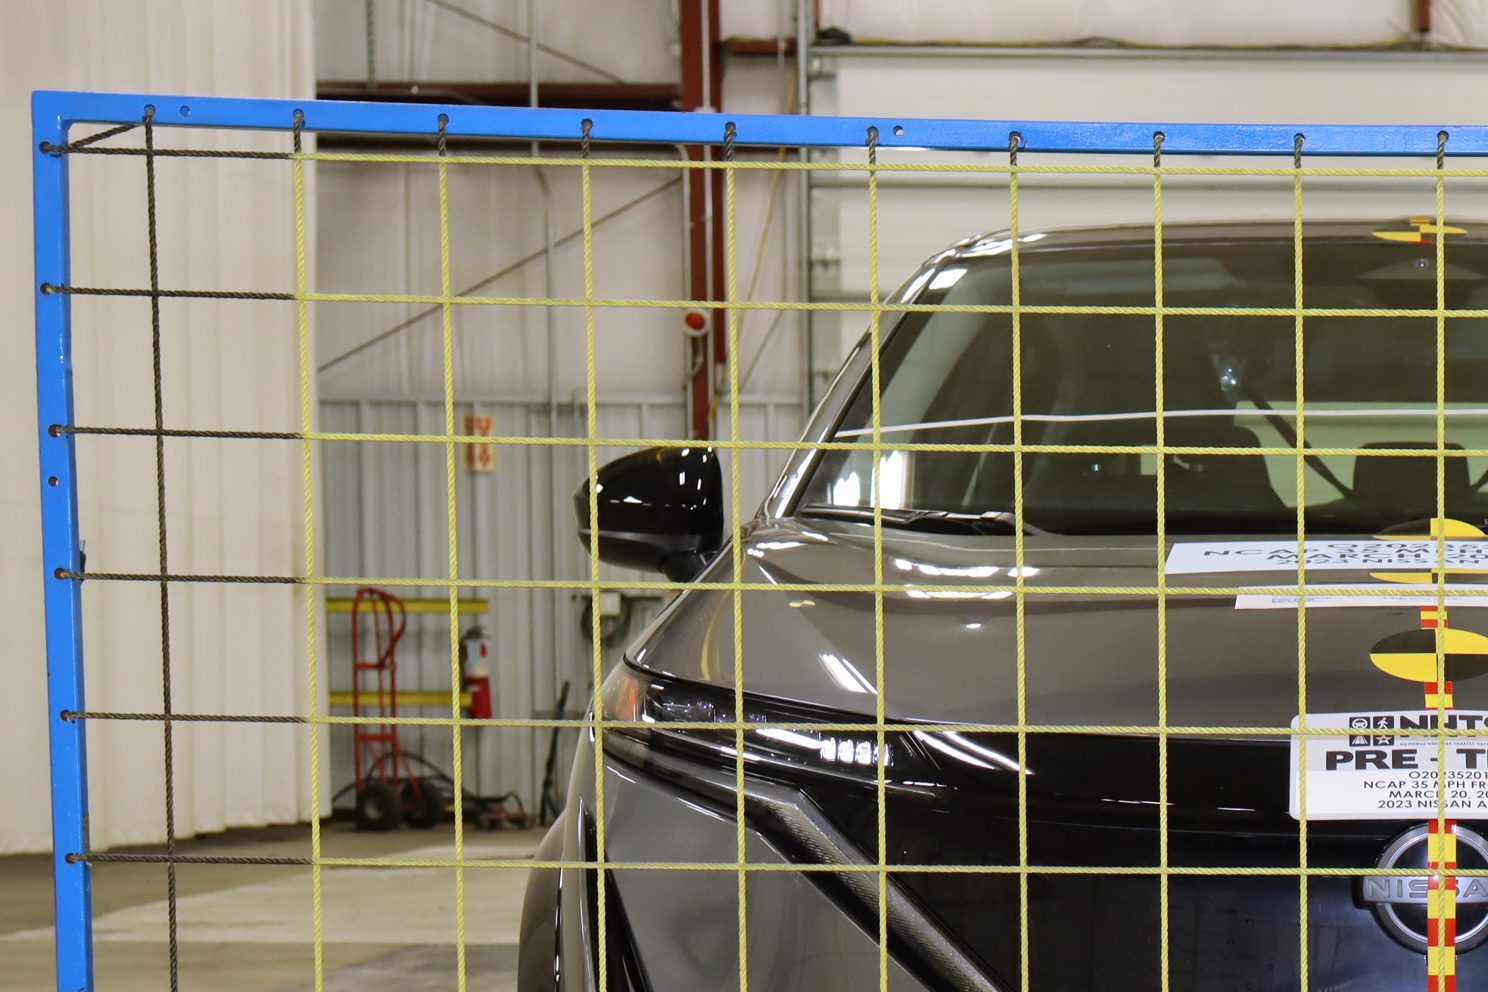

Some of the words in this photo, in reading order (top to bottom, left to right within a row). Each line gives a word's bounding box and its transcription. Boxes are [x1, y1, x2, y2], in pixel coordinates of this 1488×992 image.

[1325, 749, 1419, 771] PRE
[1364, 781, 1407, 790] NCAP
[1412, 781, 1429, 790] 35
[1450, 791, 1472, 801] 20,
[1378, 800, 1413, 809] 2023
